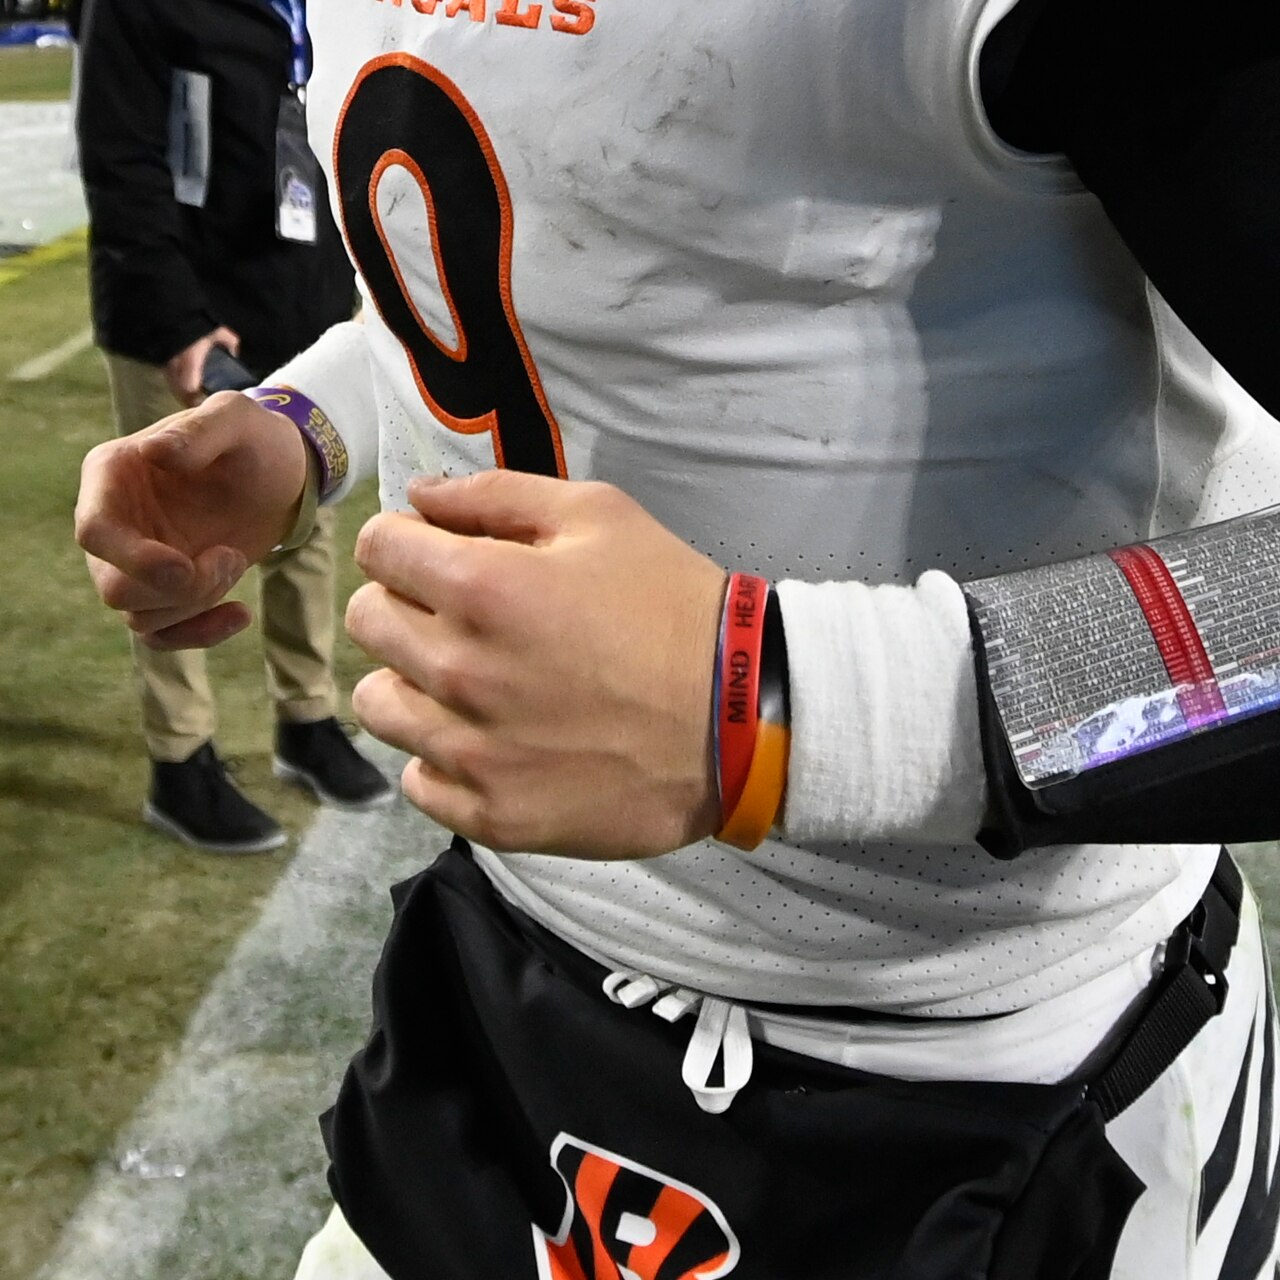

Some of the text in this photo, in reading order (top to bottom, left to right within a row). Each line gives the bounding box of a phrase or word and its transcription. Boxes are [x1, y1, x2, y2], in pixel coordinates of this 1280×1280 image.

[332, 50, 569, 483] 9
[727, 574, 761, 724] MIND HEART
